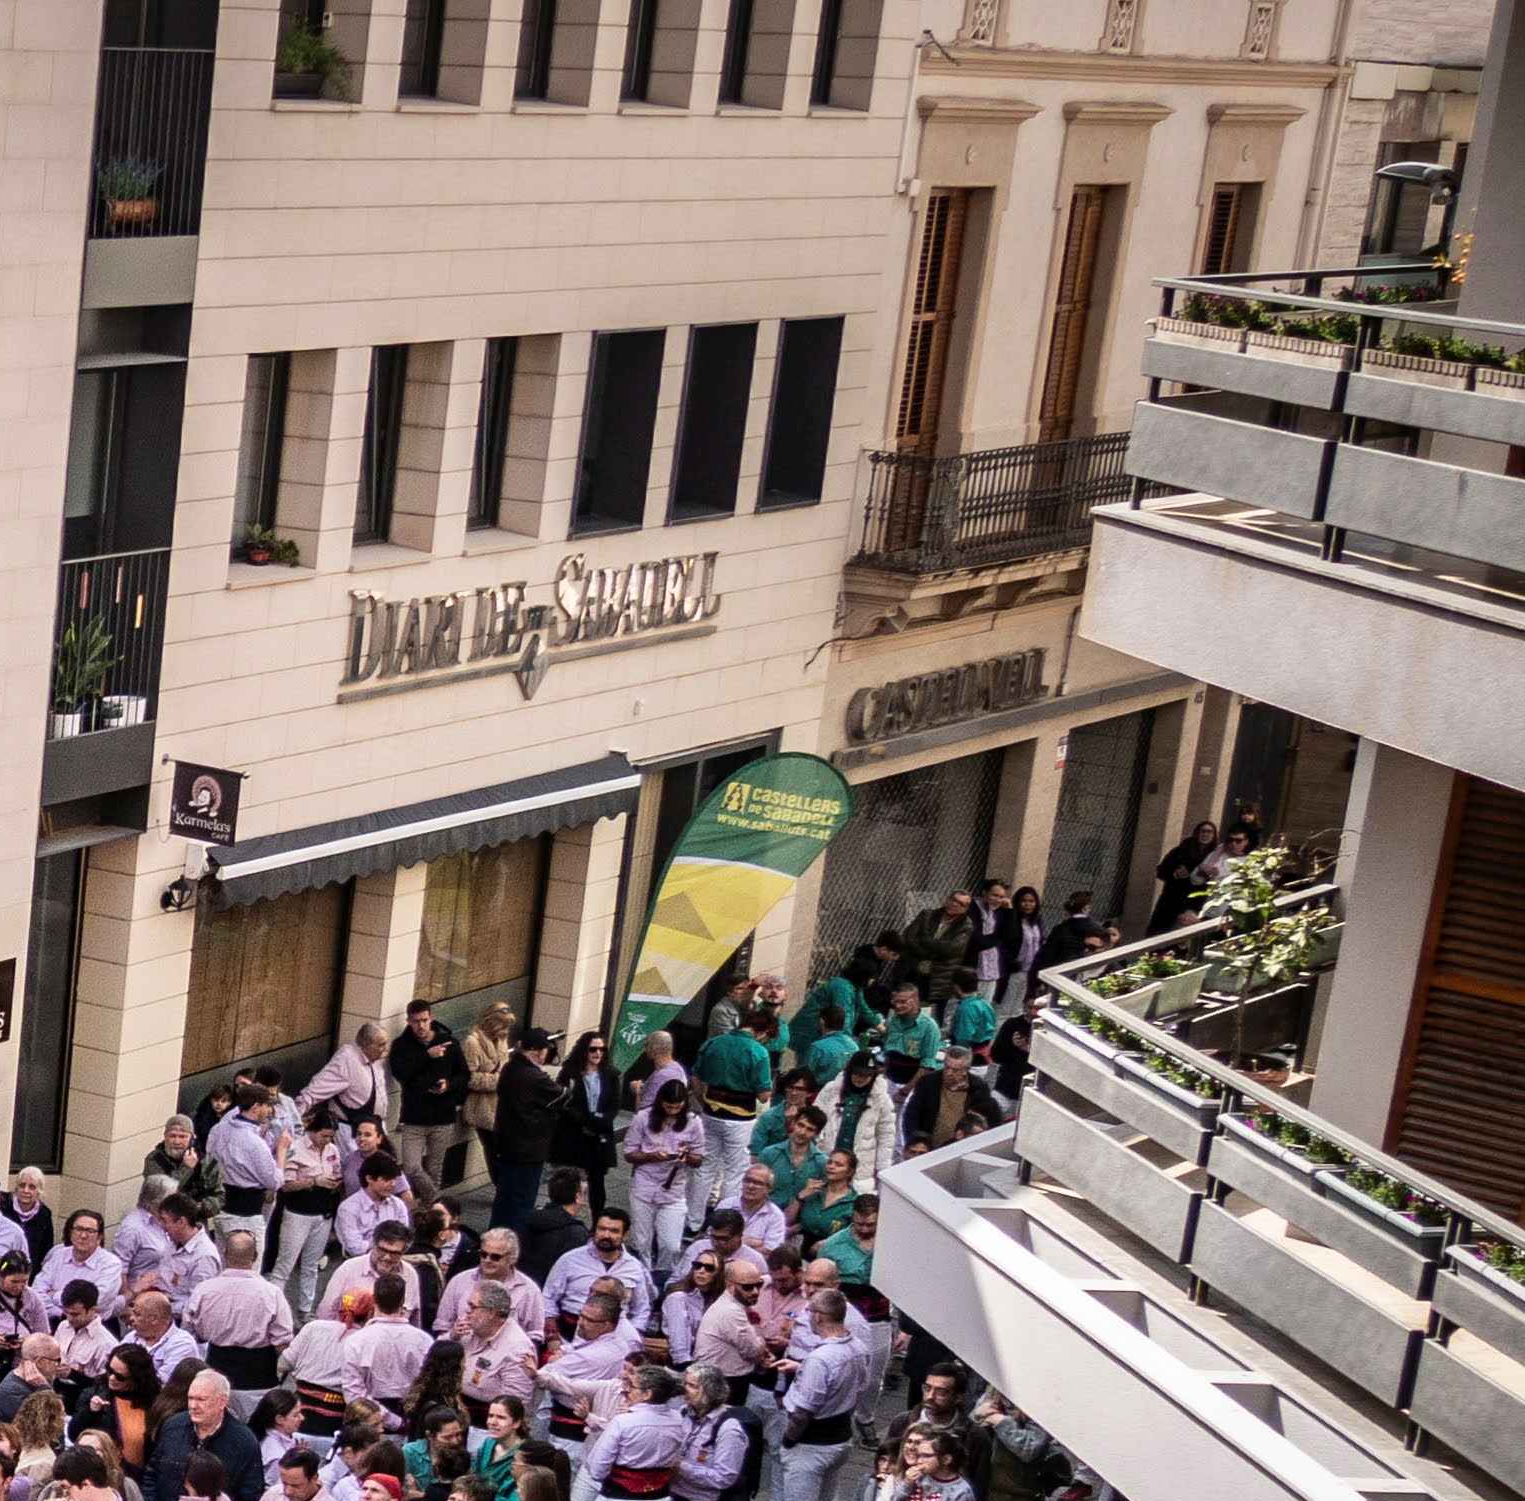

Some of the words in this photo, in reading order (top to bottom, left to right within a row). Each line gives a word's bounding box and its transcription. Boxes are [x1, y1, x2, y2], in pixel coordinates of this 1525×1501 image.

[339, 589, 464, 686] DIARI
[467, 580, 528, 662] DE
[550, 552, 722, 646] SABADELL
[175, 812, 231, 833] Karmela's
